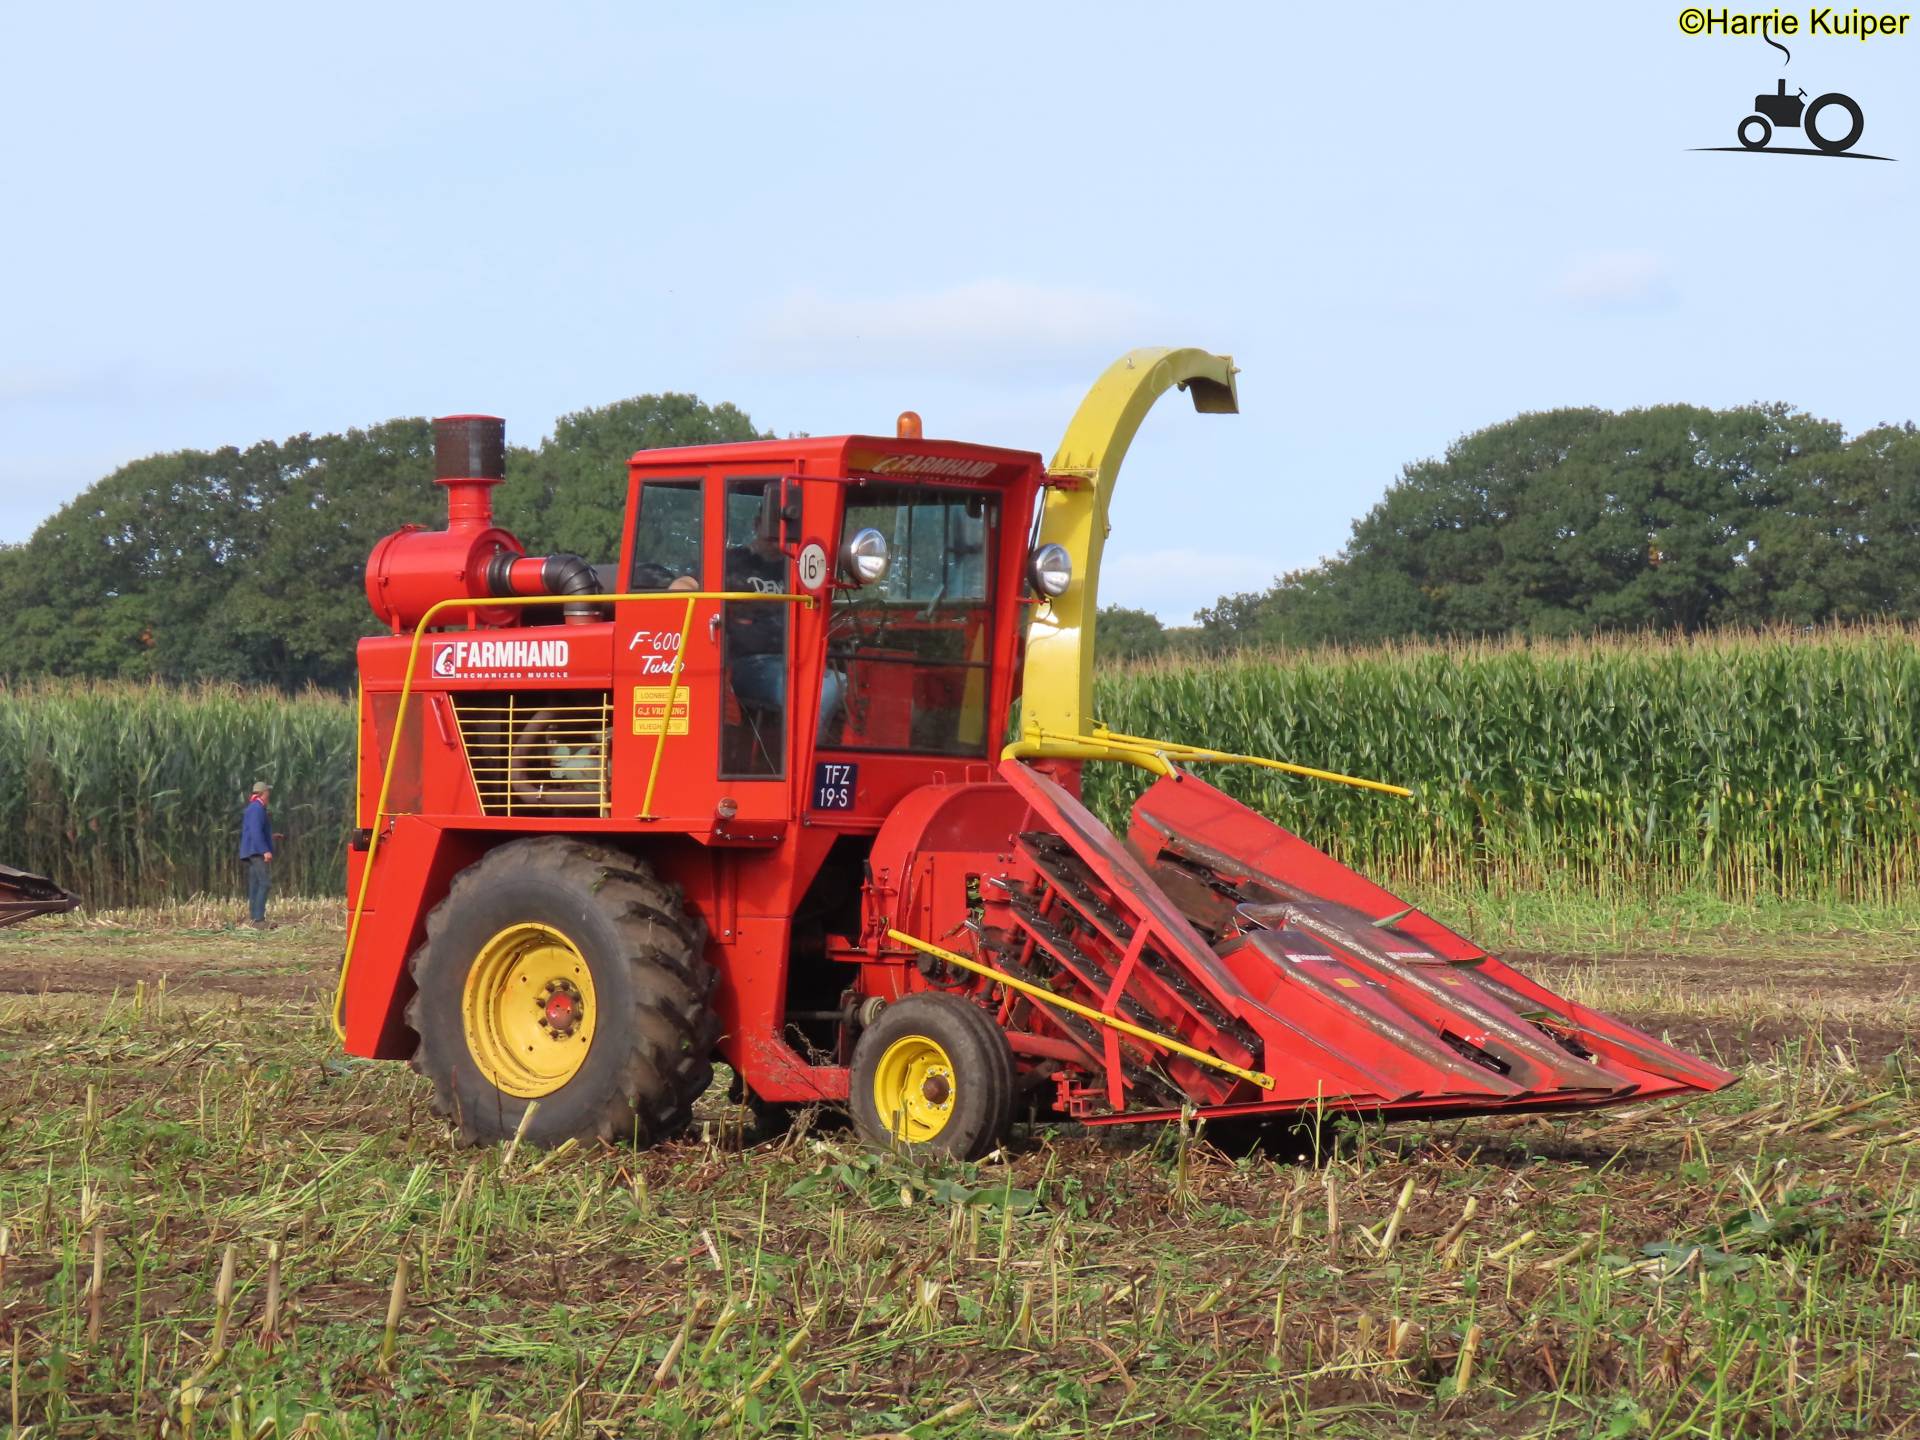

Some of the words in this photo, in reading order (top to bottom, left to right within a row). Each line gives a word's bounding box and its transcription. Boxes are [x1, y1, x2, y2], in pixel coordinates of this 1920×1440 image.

[892, 454, 998, 478] FARMHAND
[803, 553, 817, 580] 16
[629, 631, 682, 651] F-600
[456, 640, 569, 668] FARMHAND
[825, 765, 850, 785] TFZ
[820, 787, 848, 807] 19-S
